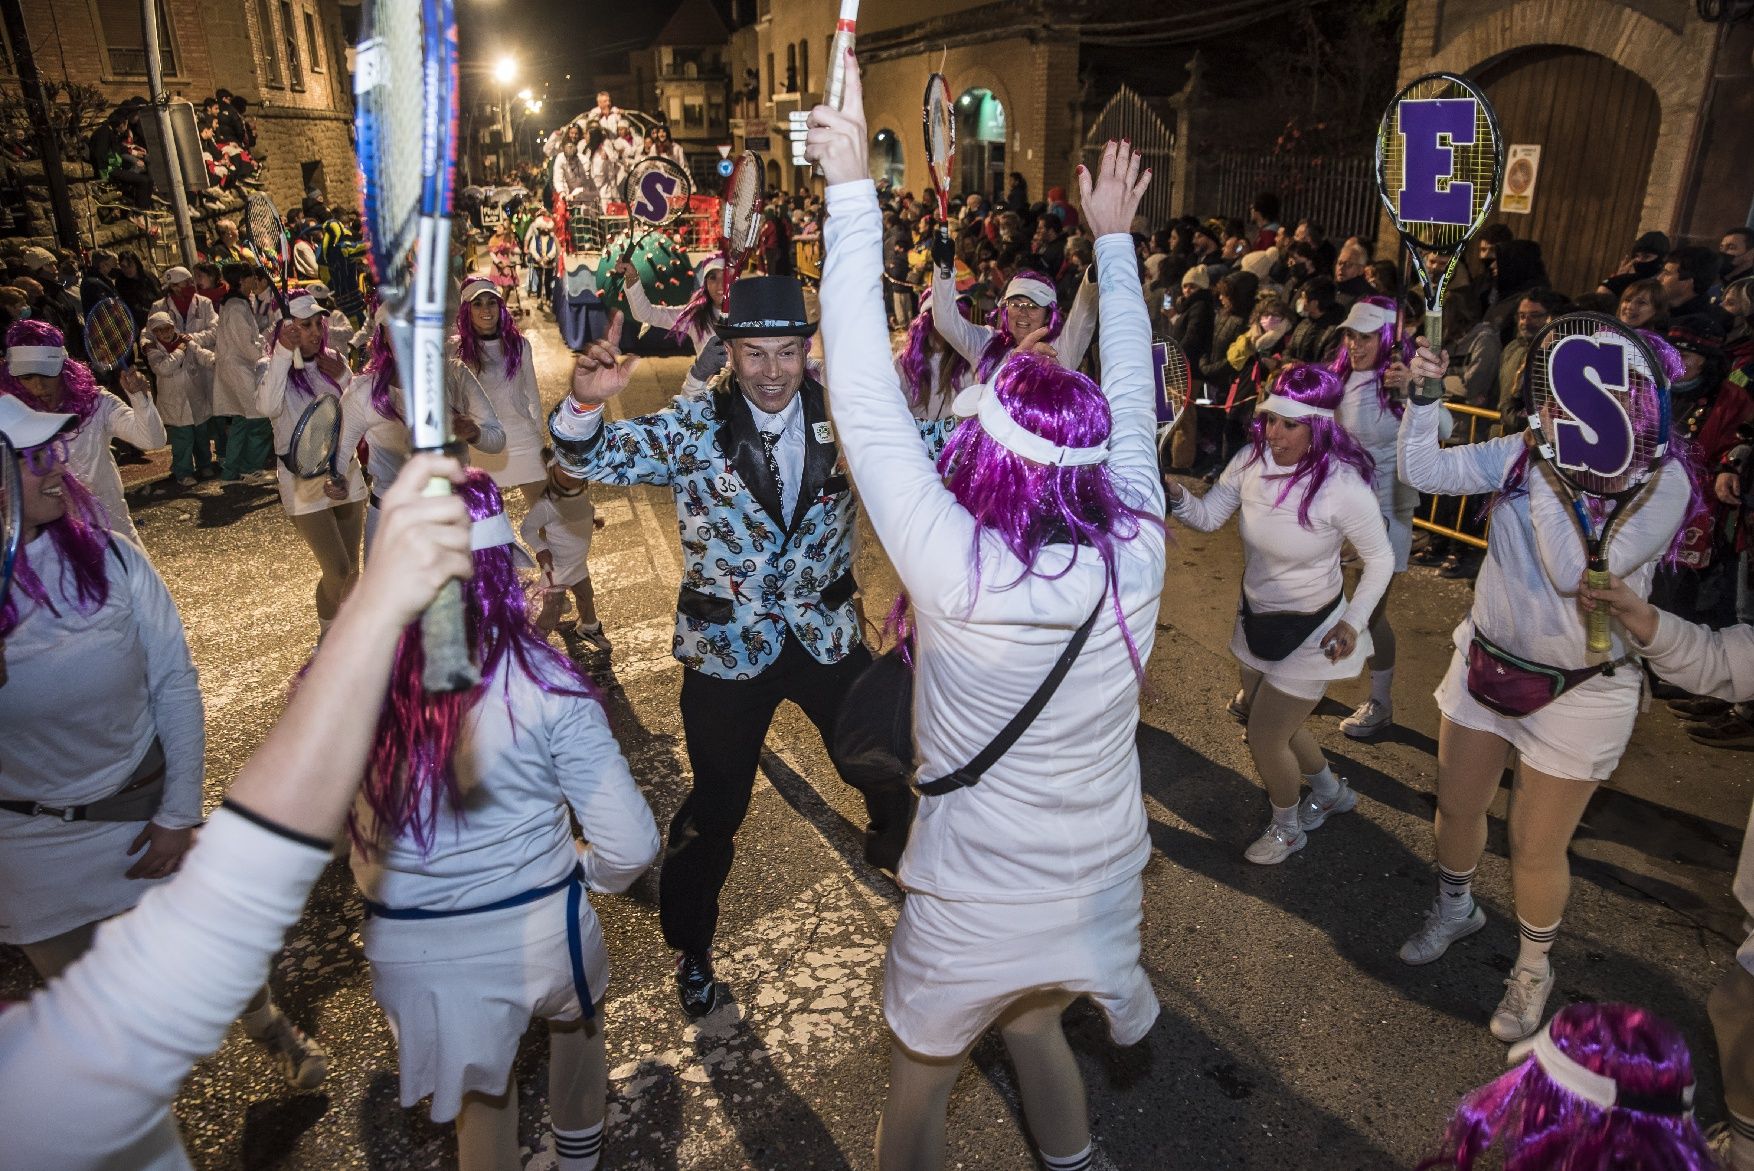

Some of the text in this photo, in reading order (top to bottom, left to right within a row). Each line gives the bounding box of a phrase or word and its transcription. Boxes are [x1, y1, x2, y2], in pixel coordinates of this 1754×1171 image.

[632, 169, 678, 224] S
[1398, 97, 1477, 226] E
[1548, 335, 1634, 478] S
[718, 476, 737, 493] 36
